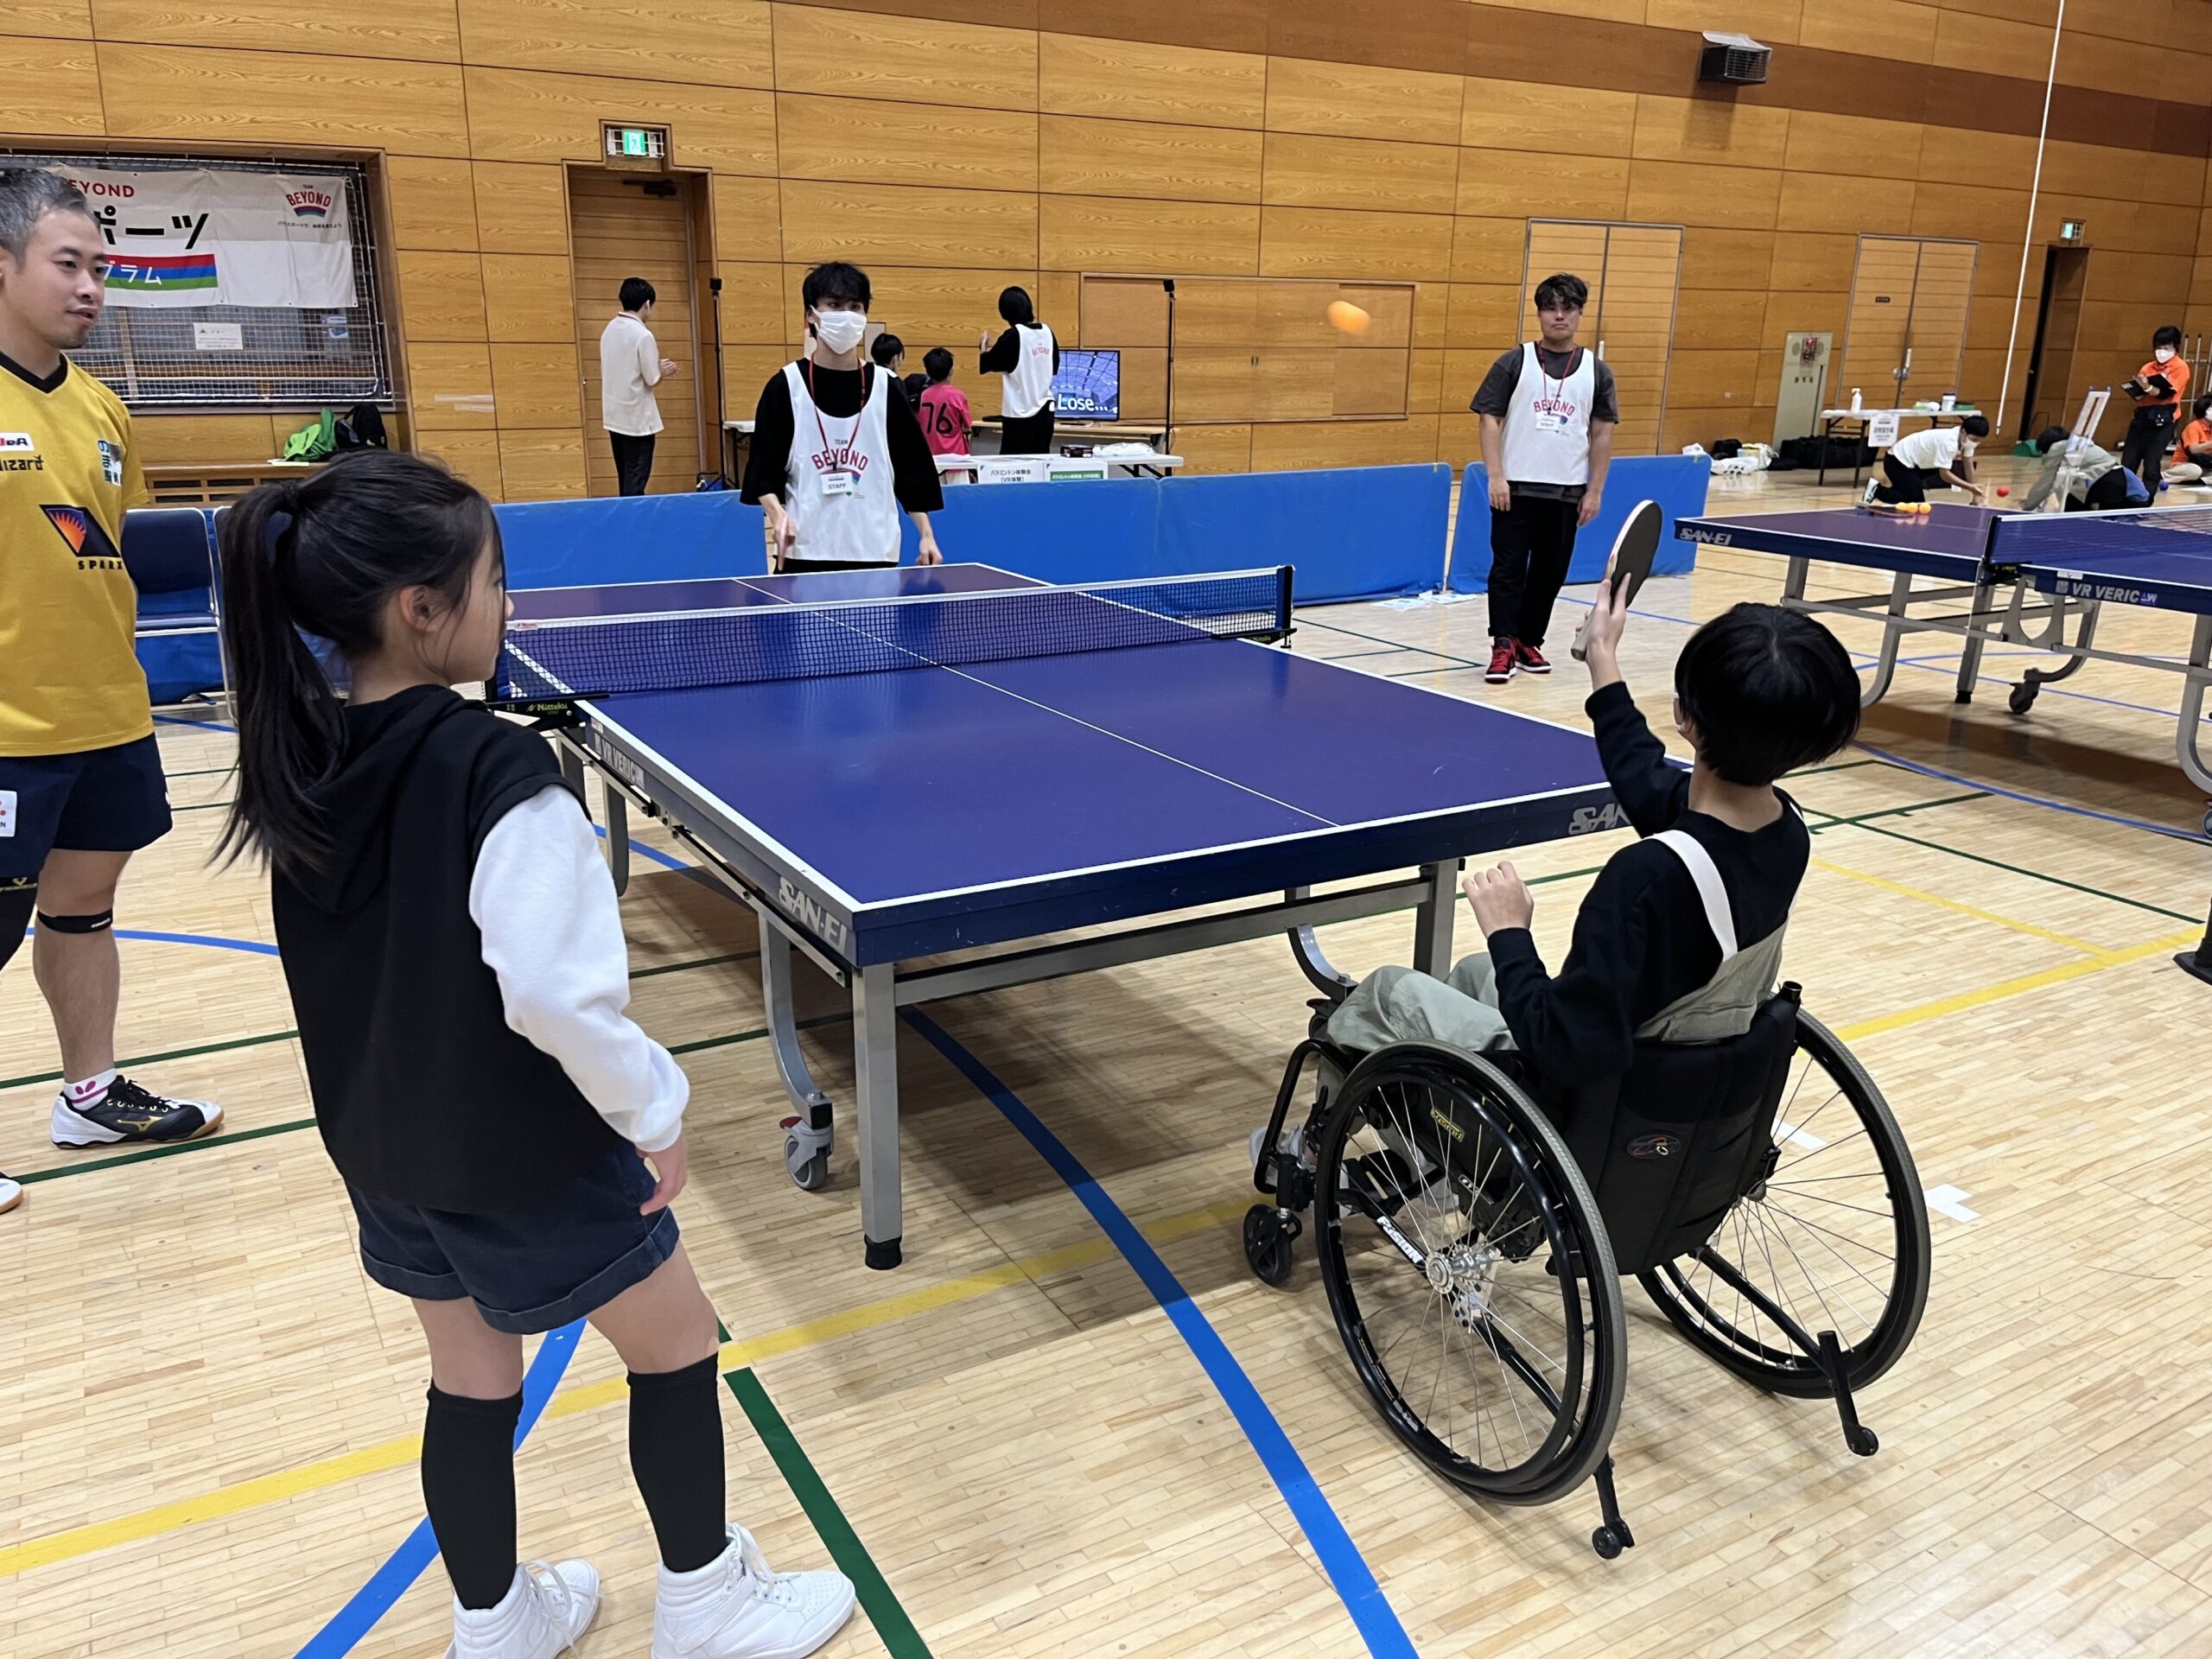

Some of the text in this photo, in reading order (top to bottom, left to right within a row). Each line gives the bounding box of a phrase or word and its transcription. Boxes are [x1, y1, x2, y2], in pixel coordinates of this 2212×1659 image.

[68, 179, 135, 198] EYOND
[286, 191, 332, 207] BEYOND
[1057, 393, 1109, 411] Lose...
[1533, 399, 1575, 416] BEYOND
[921, 402, 953, 434] 76
[810, 448, 868, 471] BEYOND
[2072, 582, 2092, 597] VR
[2095, 585, 2140, 603] VERIC
